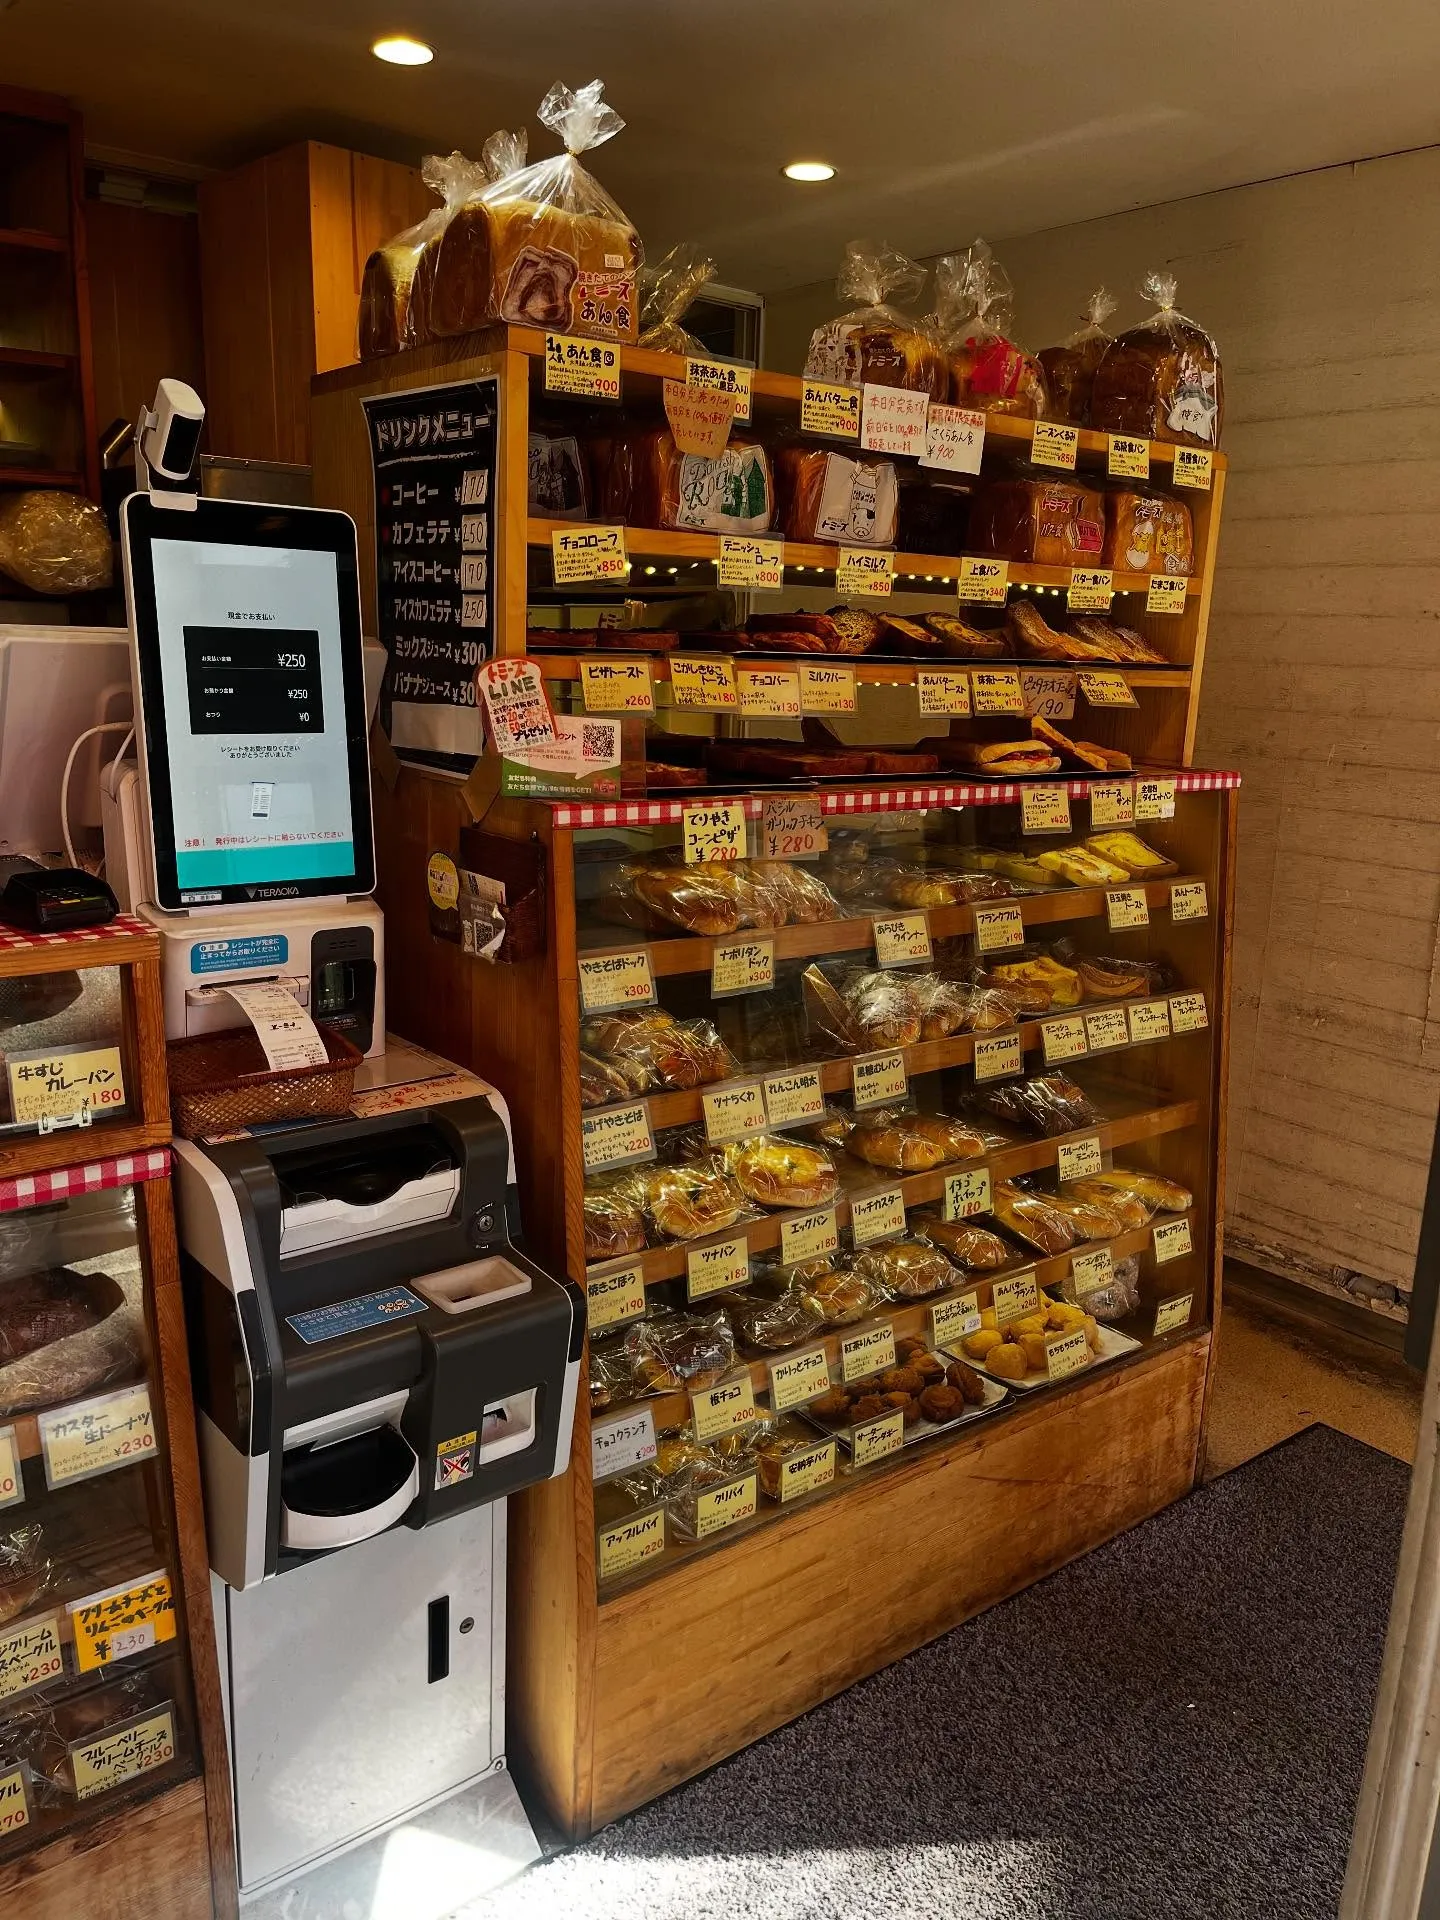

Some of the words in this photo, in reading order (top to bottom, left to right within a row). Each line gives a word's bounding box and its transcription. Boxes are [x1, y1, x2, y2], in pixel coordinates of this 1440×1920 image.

[580, 300, 631, 328] あん食
[566, 344, 602, 363] あん食
[689, 363, 737, 383] 抹茶あん食
[805, 388, 858, 409] あんバター食
[376, 410, 492, 452] ドリンクメニュー
[836, 417, 858, 431] ¥900
[927, 444, 955, 460] ¥900
[1112, 439, 1146, 455] 高級食パン
[392, 481, 439, 506] コーヒー
[392, 519, 451, 545] カフェラテ
[559, 533, 619, 551] チョコローフ
[597, 558, 625, 573] ¥850
[755, 554, 779, 567] ローフ
[847, 554, 887, 569] ハイミルク
[392, 560, 451, 584] アイスコーヒー
[755, 571, 779, 583] ¥800
[970, 563, 1000, 576] 上食パン
[1072, 573, 1111, 586] バター食パン
[228, 611, 276, 621] 現金でお支払い
[393, 597, 452, 623] アイスカフェラテ
[395, 634, 452, 660] ミックスジュース
[454, 641, 487, 666] ¥300
[277, 653, 306, 668] ¥250
[487, 661, 528, 683] トミーズ
[588, 666, 645, 679] ピザトースト
[750, 674, 790, 686] チョコバー
[808, 670, 847, 682] ミルクバー
[922, 675, 955, 686] あんバター
[393, 671, 451, 697] バナナジュース
[488, 675, 537, 700] LINE
[701, 676, 731, 687] トースト
[288, 689, 309, 699] ¥250
[625, 694, 651, 707] ¥260
[299, 711, 310, 722] ¥0
[230, 751, 293, 759] ありがとうございました
[688, 810, 731, 827] てりやき
[768, 834, 814, 856] ¥280
[257, 886, 300, 898] TERAOKA
[978, 910, 1021, 925] フランクフルト
[877, 922, 905, 935] あらびき
[719, 945, 762, 960] ナポリタン
[748, 954, 770, 968] ドック
[581, 956, 645, 974] やきそばドック
[749, 969, 771, 981] ¥300
[624, 983, 651, 996] ¥300
[976, 1037, 1019, 1054] ホイップコルネ
[18, 1061, 63, 1081] 牛すじ
[45, 1069, 115, 1092] カレーパン
[768, 1075, 818, 1094] れんこん明太
[82, 1088, 122, 1107] ¥180
[713, 1090, 755, 1108] ツナちくわ
[801, 1100, 822, 1113] ¥220
[743, 1114, 764, 1127] ¥210
[625, 1137, 650, 1152] ¥220
[854, 1195, 902, 1214] リッチカスター
[953, 1200, 981, 1219] ¥180
[883, 1215, 903, 1229] ¥190
[815, 1236, 837, 1251] ¥180
[702, 1245, 737, 1263] ツナパン
[724, 1267, 747, 1282] ¥180
[620, 1298, 643, 1314] ¥190
[808, 1376, 829, 1393] ¥190
[732, 1407, 755, 1424] ¥200
[53, 1414, 109, 1439] カスター
[84, 1411, 150, 1446] 生ドーナツ
[594, 1420, 648, 1449] チョコクランチ
[113, 1434, 153, 1457] ¥230
[812, 1468, 834, 1485] ¥220
[731, 1502, 755, 1520] ¥220
[605, 1515, 660, 1548] アップルパイ
[639, 1538, 665, 1557] ¥220
[22, 1657, 61, 1684] ¥230
[80, 1729, 149, 1762] ブルーベリー
[92, 1729, 168, 1770] クリームチーズ
[136, 1744, 173, 1770] ¥230
